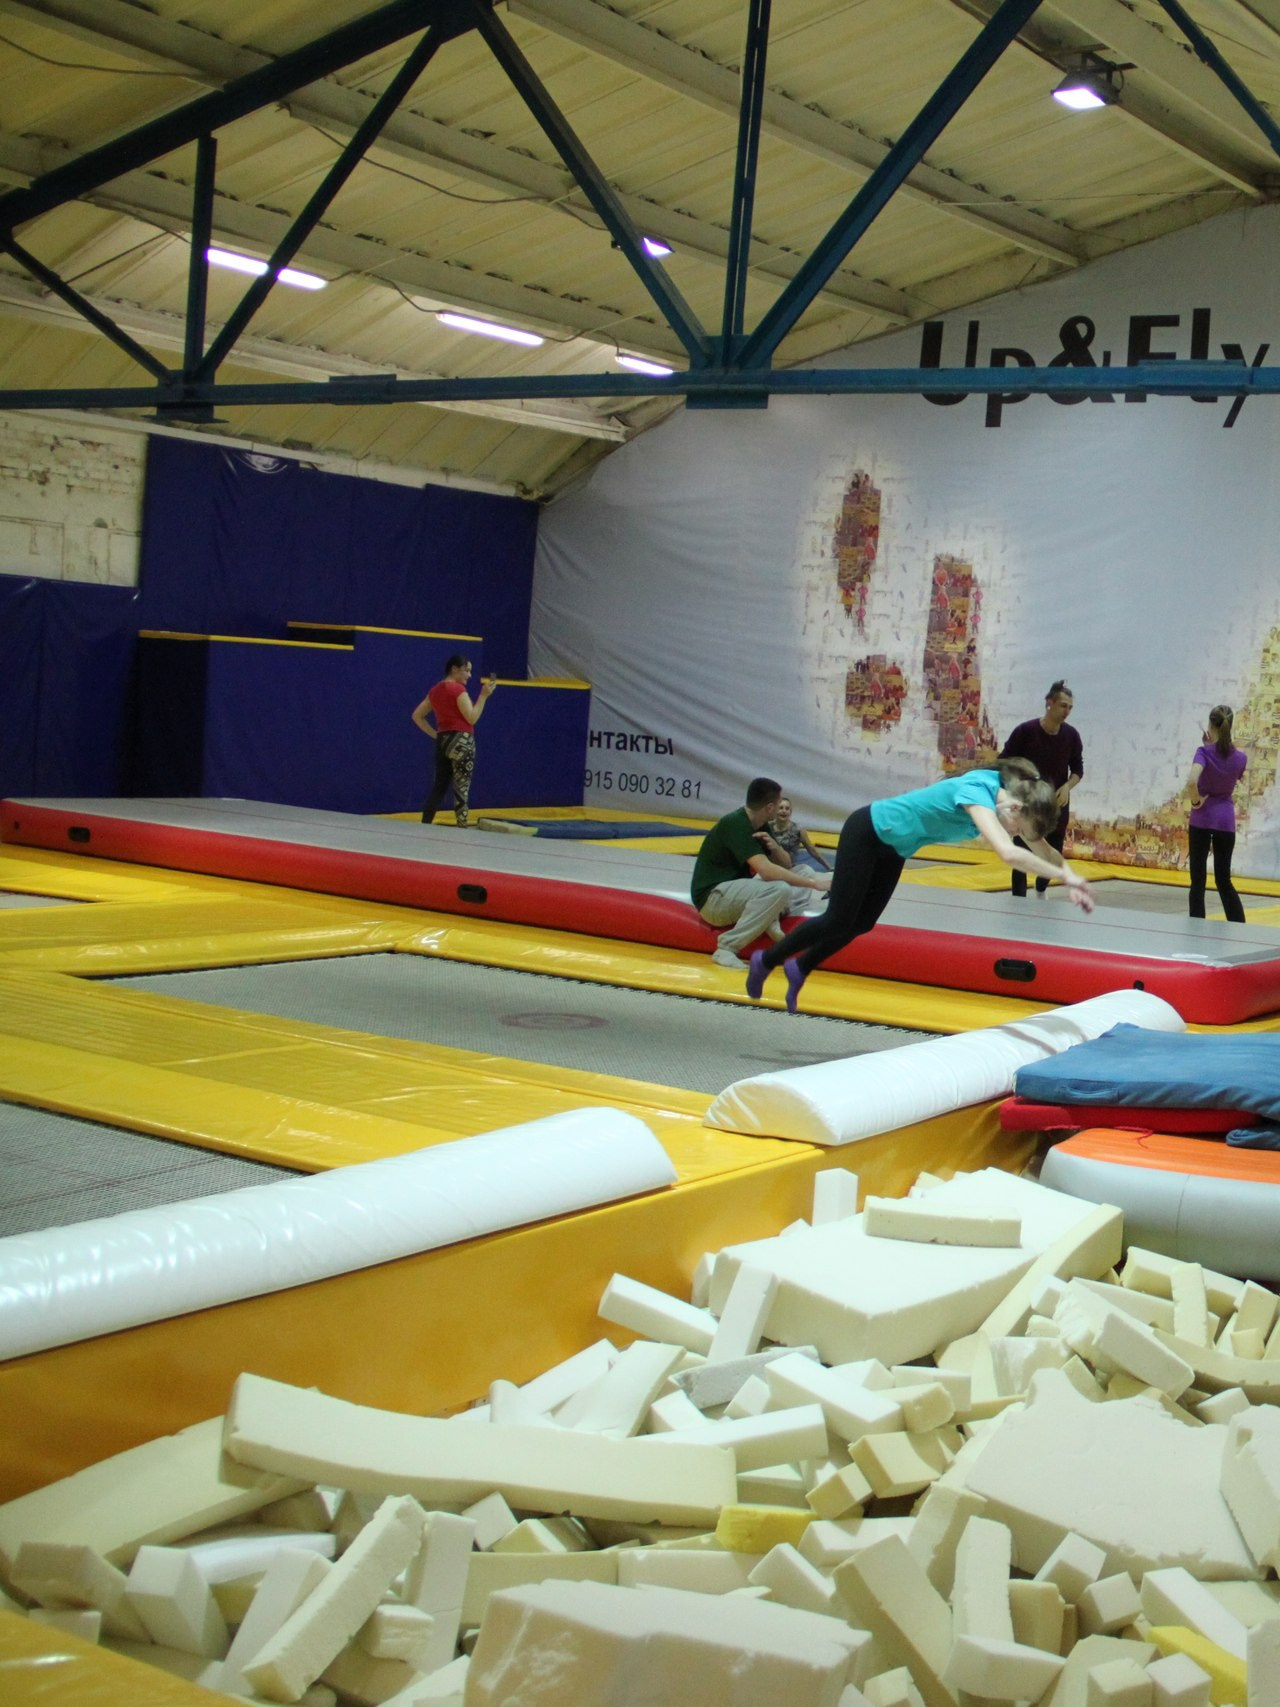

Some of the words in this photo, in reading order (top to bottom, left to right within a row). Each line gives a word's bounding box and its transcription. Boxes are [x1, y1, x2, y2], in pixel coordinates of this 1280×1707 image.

[919, 308, 1271, 428] Up&Fly
[618, 773, 649, 794] 090
[655, 776, 675, 797] 32
[681, 780, 702, 800] 81
